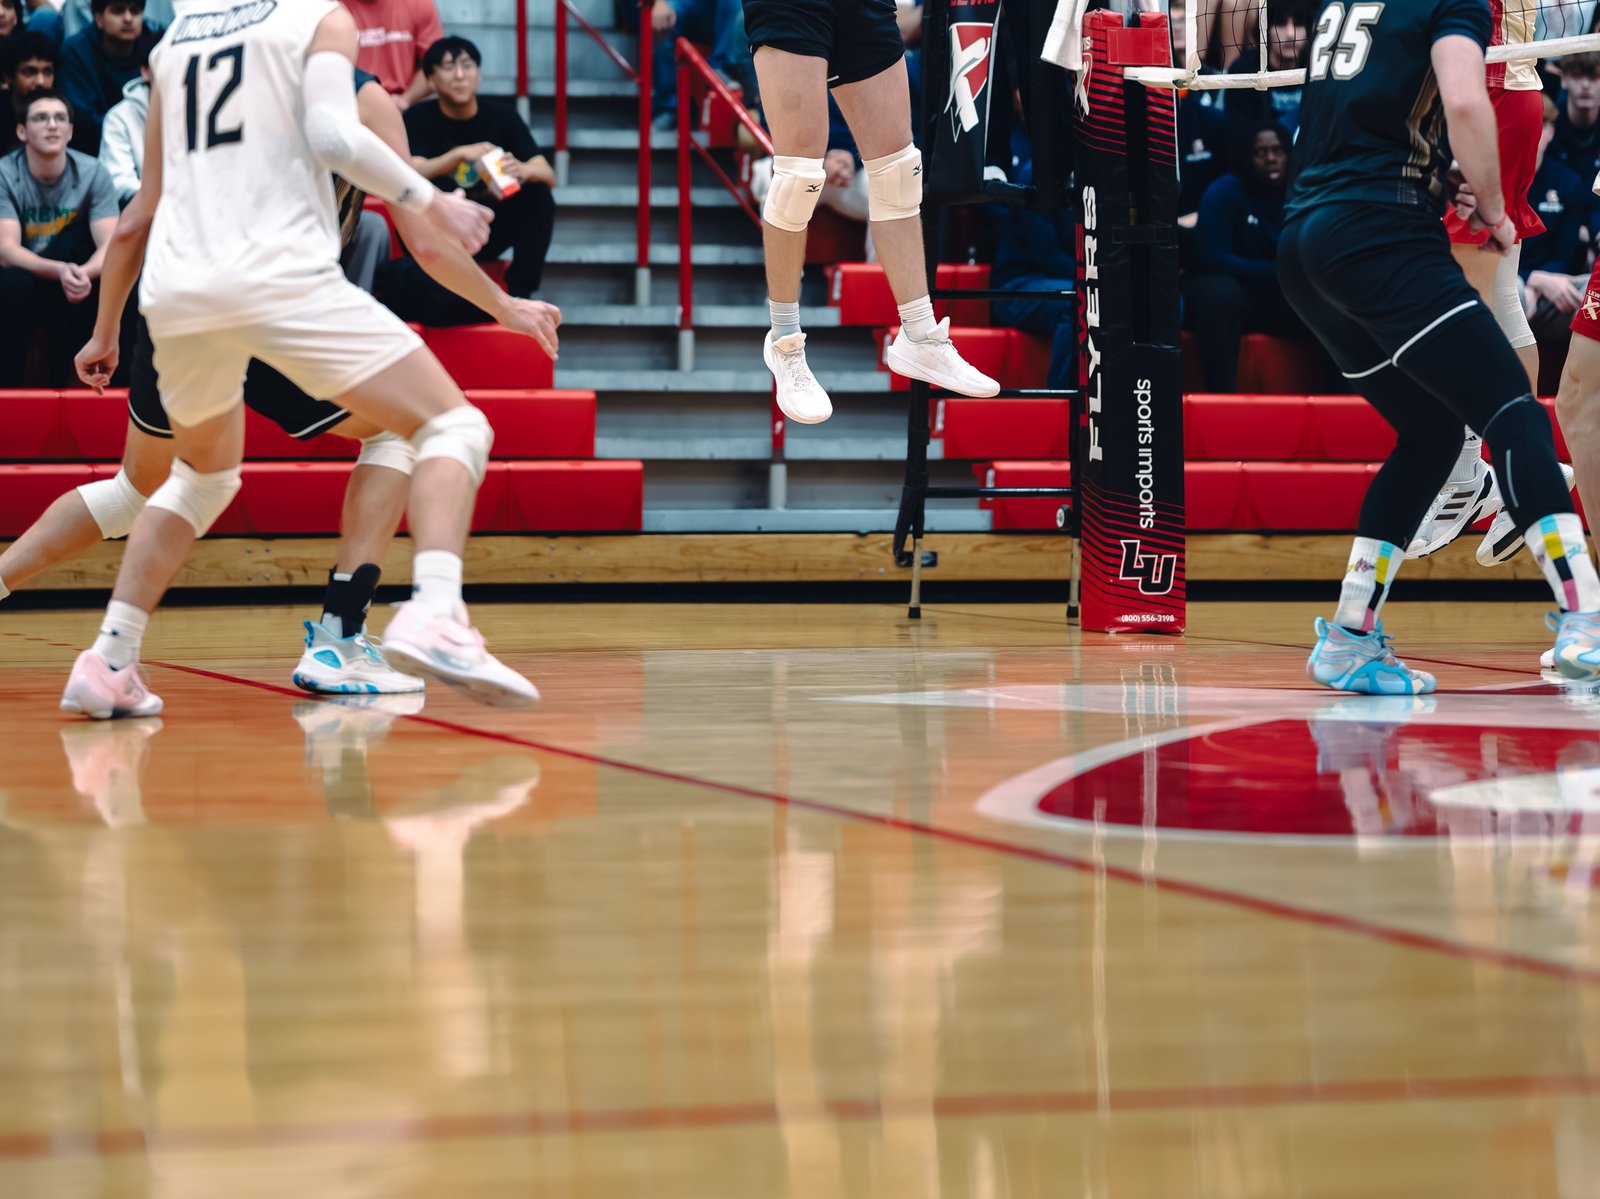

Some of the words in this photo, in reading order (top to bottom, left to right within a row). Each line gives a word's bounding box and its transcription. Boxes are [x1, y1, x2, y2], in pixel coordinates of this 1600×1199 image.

[1310, 1, 1385, 82] 25
[182, 42, 244, 155] 12
[1082, 186, 1103, 462] FLYERS
[1133, 378, 1154, 444] sports
[1135, 448, 1156, 529] imports
[1119, 539, 1177, 596] LU
[1121, 614, 1140, 623] (800)
[1141, 614, 1175, 622] 556-3198
